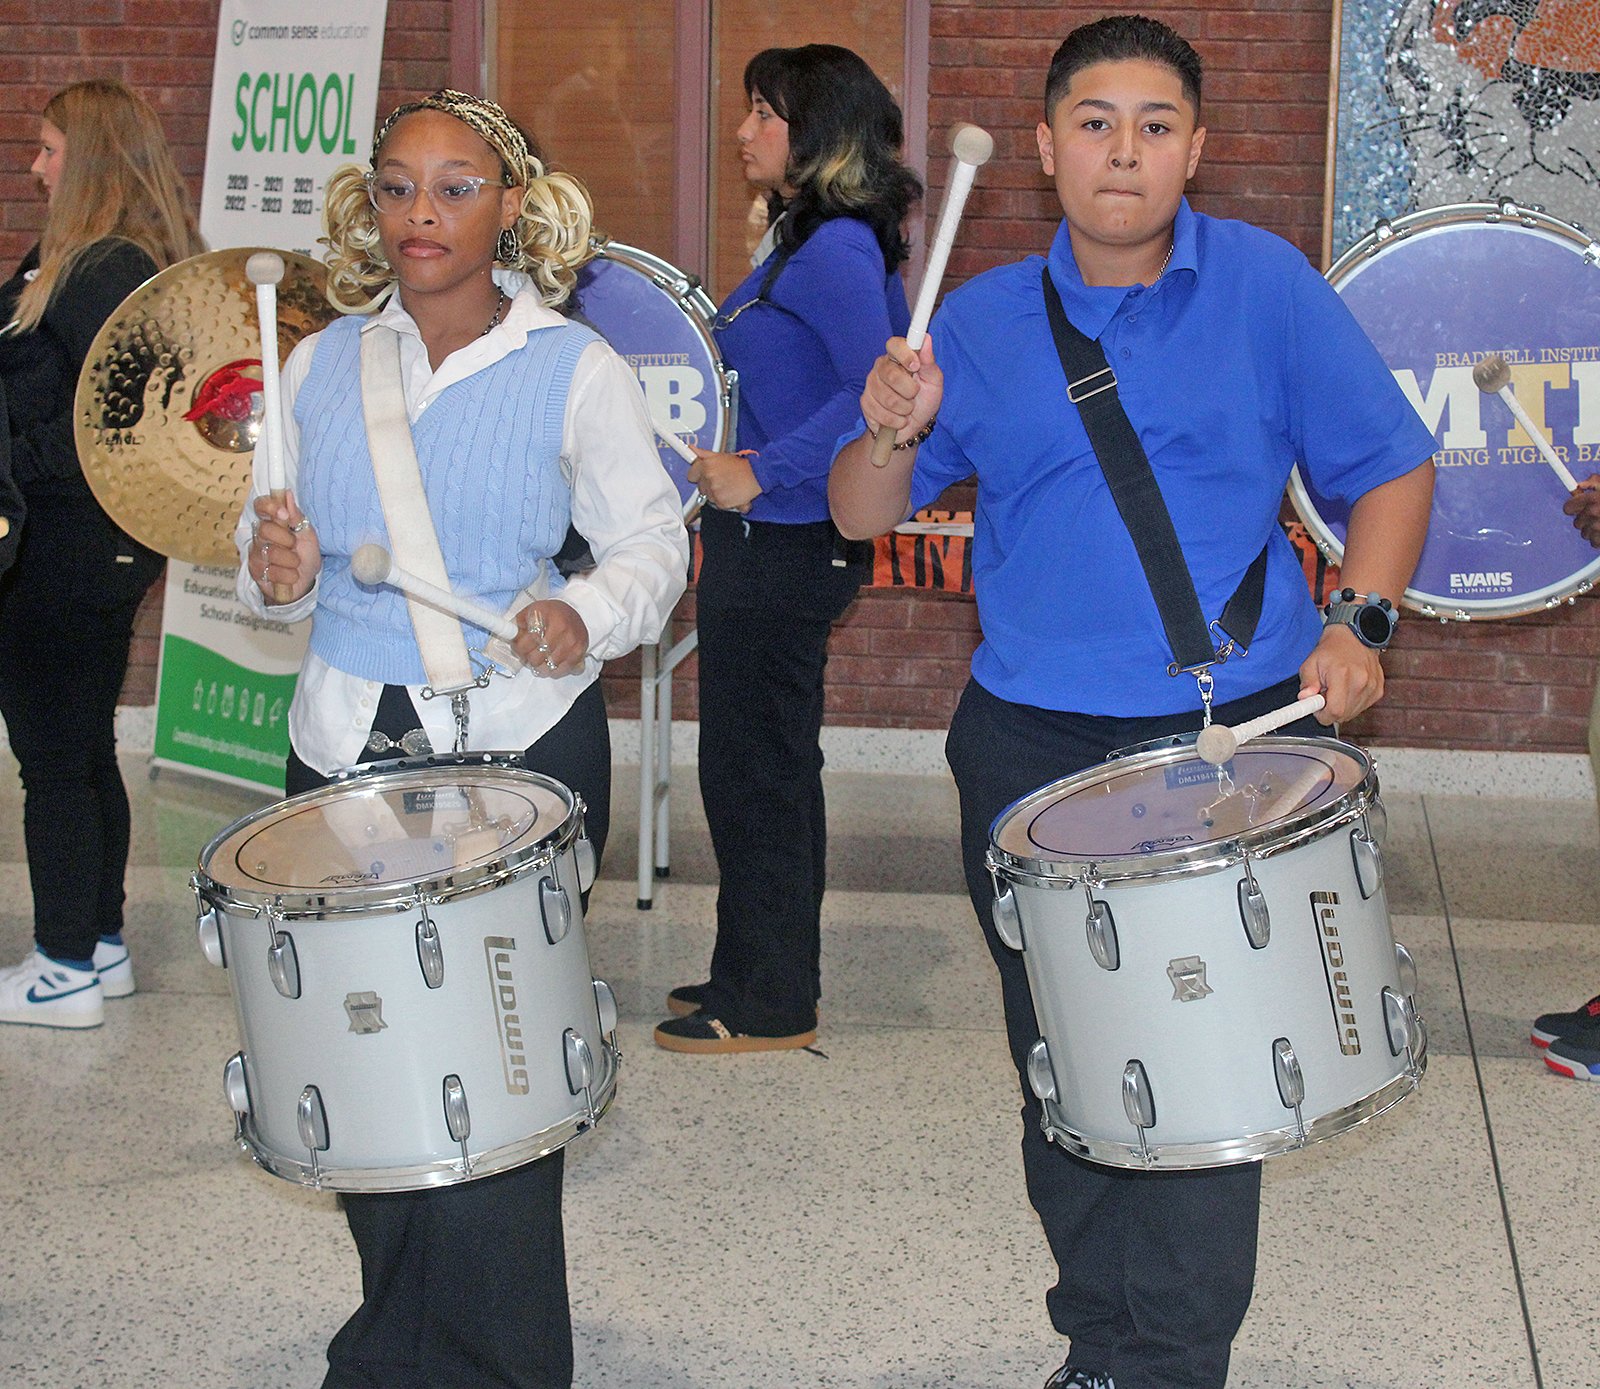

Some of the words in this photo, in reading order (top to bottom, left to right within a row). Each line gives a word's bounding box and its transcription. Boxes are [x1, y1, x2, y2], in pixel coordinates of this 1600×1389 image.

[249, 25, 289, 40] common
[291, 25, 319, 40] sense
[321, 22, 370, 40] education
[231, 72, 356, 154] SCHOOL
[183, 578, 234, 601] Education
[1450, 571, 1513, 588] EVANS
[1450, 587, 1513, 595] DRUMHEADS
[200, 602, 233, 622] School
[1309, 891, 1362, 1056] LUDWIG
[484, 936, 531, 1096] LUDWIG
